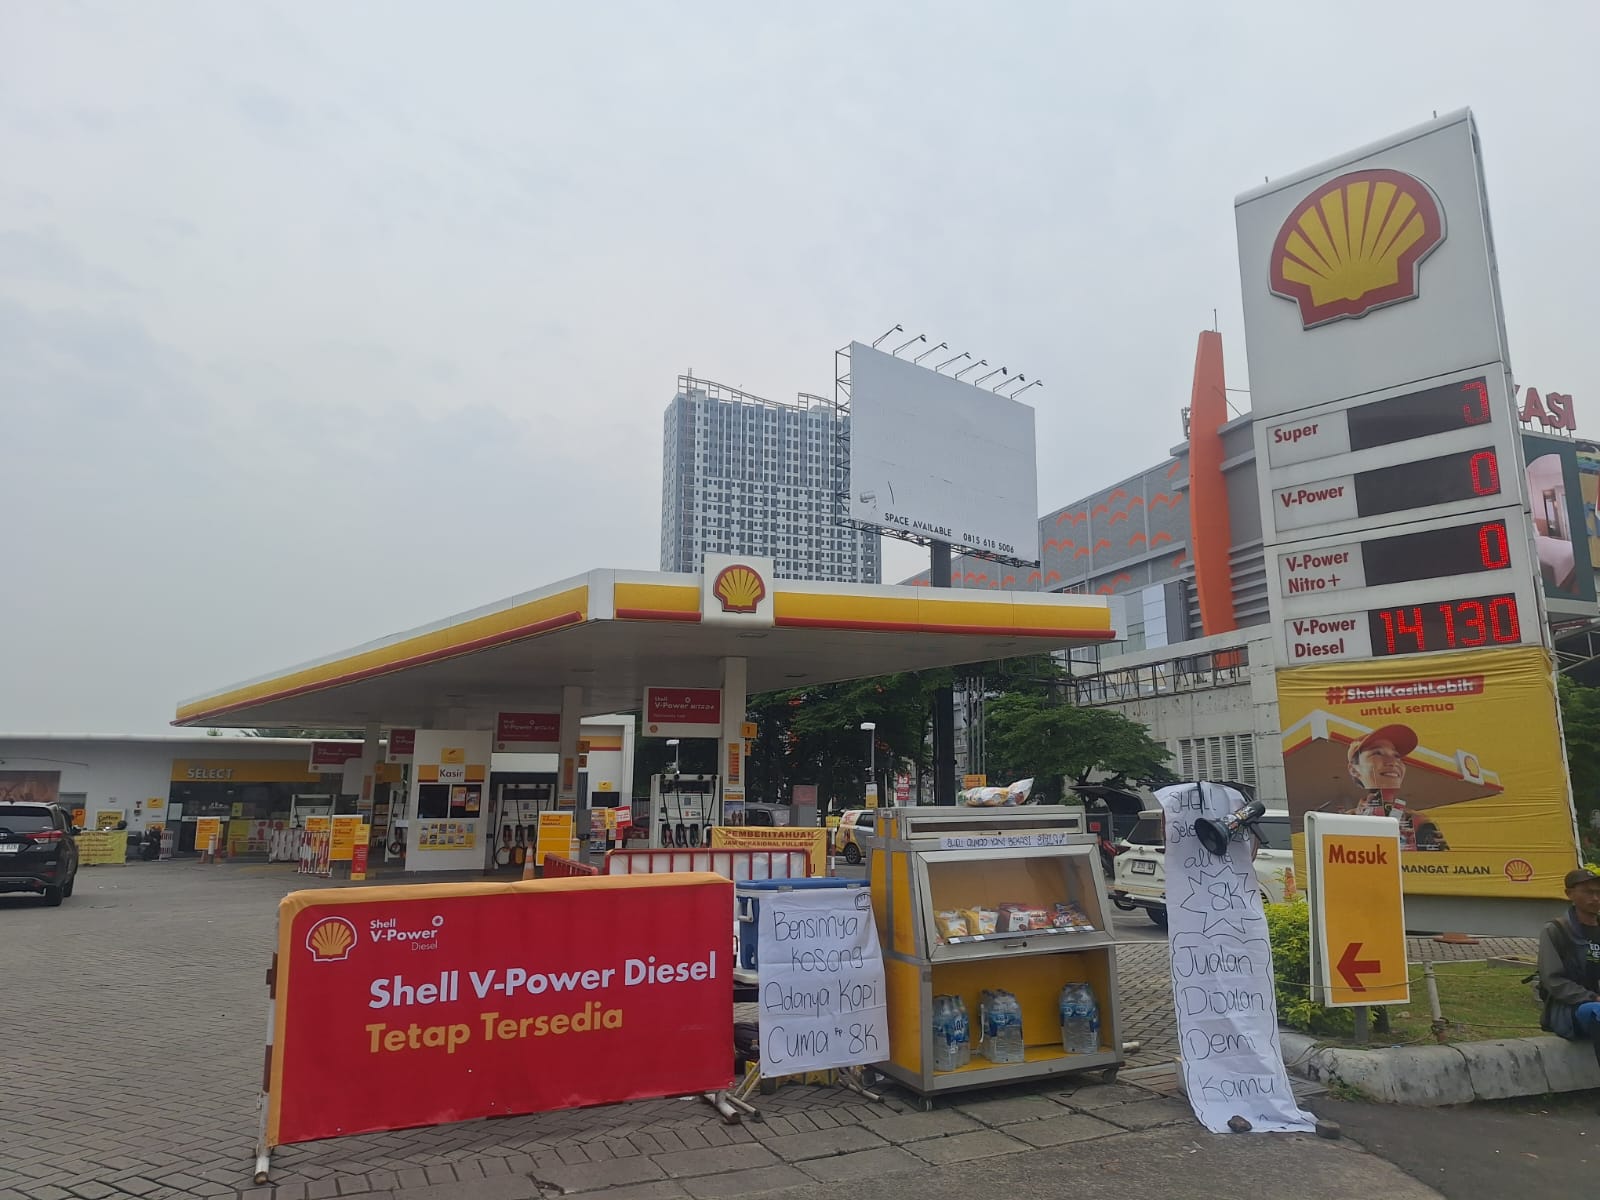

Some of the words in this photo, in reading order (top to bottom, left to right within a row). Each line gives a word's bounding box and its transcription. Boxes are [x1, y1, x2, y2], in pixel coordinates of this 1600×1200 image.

[1273, 423, 1319, 444] Super
[1469, 451, 1500, 496] 0
[1280, 485, 1345, 508] V-Power
[884, 512, 910, 526] SPACE
[912, 520, 953, 537] AVAILABLE
[962, 532, 981, 545] 0815
[983, 538, 996, 549] 618
[1478, 523, 1509, 569] 0
[1285, 551, 1350, 572] V-Power
[1292, 618, 1357, 637] V-Power
[1294, 637, 1345, 658] Diesel
[1325, 679, 1474, 706] #ShellKasihLebih
[1360, 703, 1400, 717] untuk
[1405, 702, 1455, 714] semua
[187, 768, 233, 780] SELECT
[439, 768, 464, 779] Kasir
[725, 830, 815, 839] PEMBERITAHUAN
[1328, 843, 1388, 865] Masuk
[1452, 865, 1491, 875] JALAN
[1207, 881, 1247, 911] 8K
[369, 918, 397, 929] Shell
[370, 929, 438, 943] V-Power
[773, 911, 859, 942] Bensinnya
[411, 939, 438, 951] Diesel
[1176, 944, 1254, 978] Jualan
[367, 970, 459, 1009] Shell
[468, 966, 616, 1000] V-Power
[624, 950, 717, 987] Diesel
[764, 981, 830, 1018] Adanya
[838, 978, 878, 1014] Kopi
[1181, 986, 1265, 1016] Dijalan
[365, 1021, 471, 1054] Tetap
[479, 1001, 624, 1042] Tersedia
[767, 1025, 829, 1064] Cuma
[848, 1023, 879, 1055] 8K
[1185, 1028, 1257, 1060] Demi
[1198, 1074, 1275, 1106] Kamu
